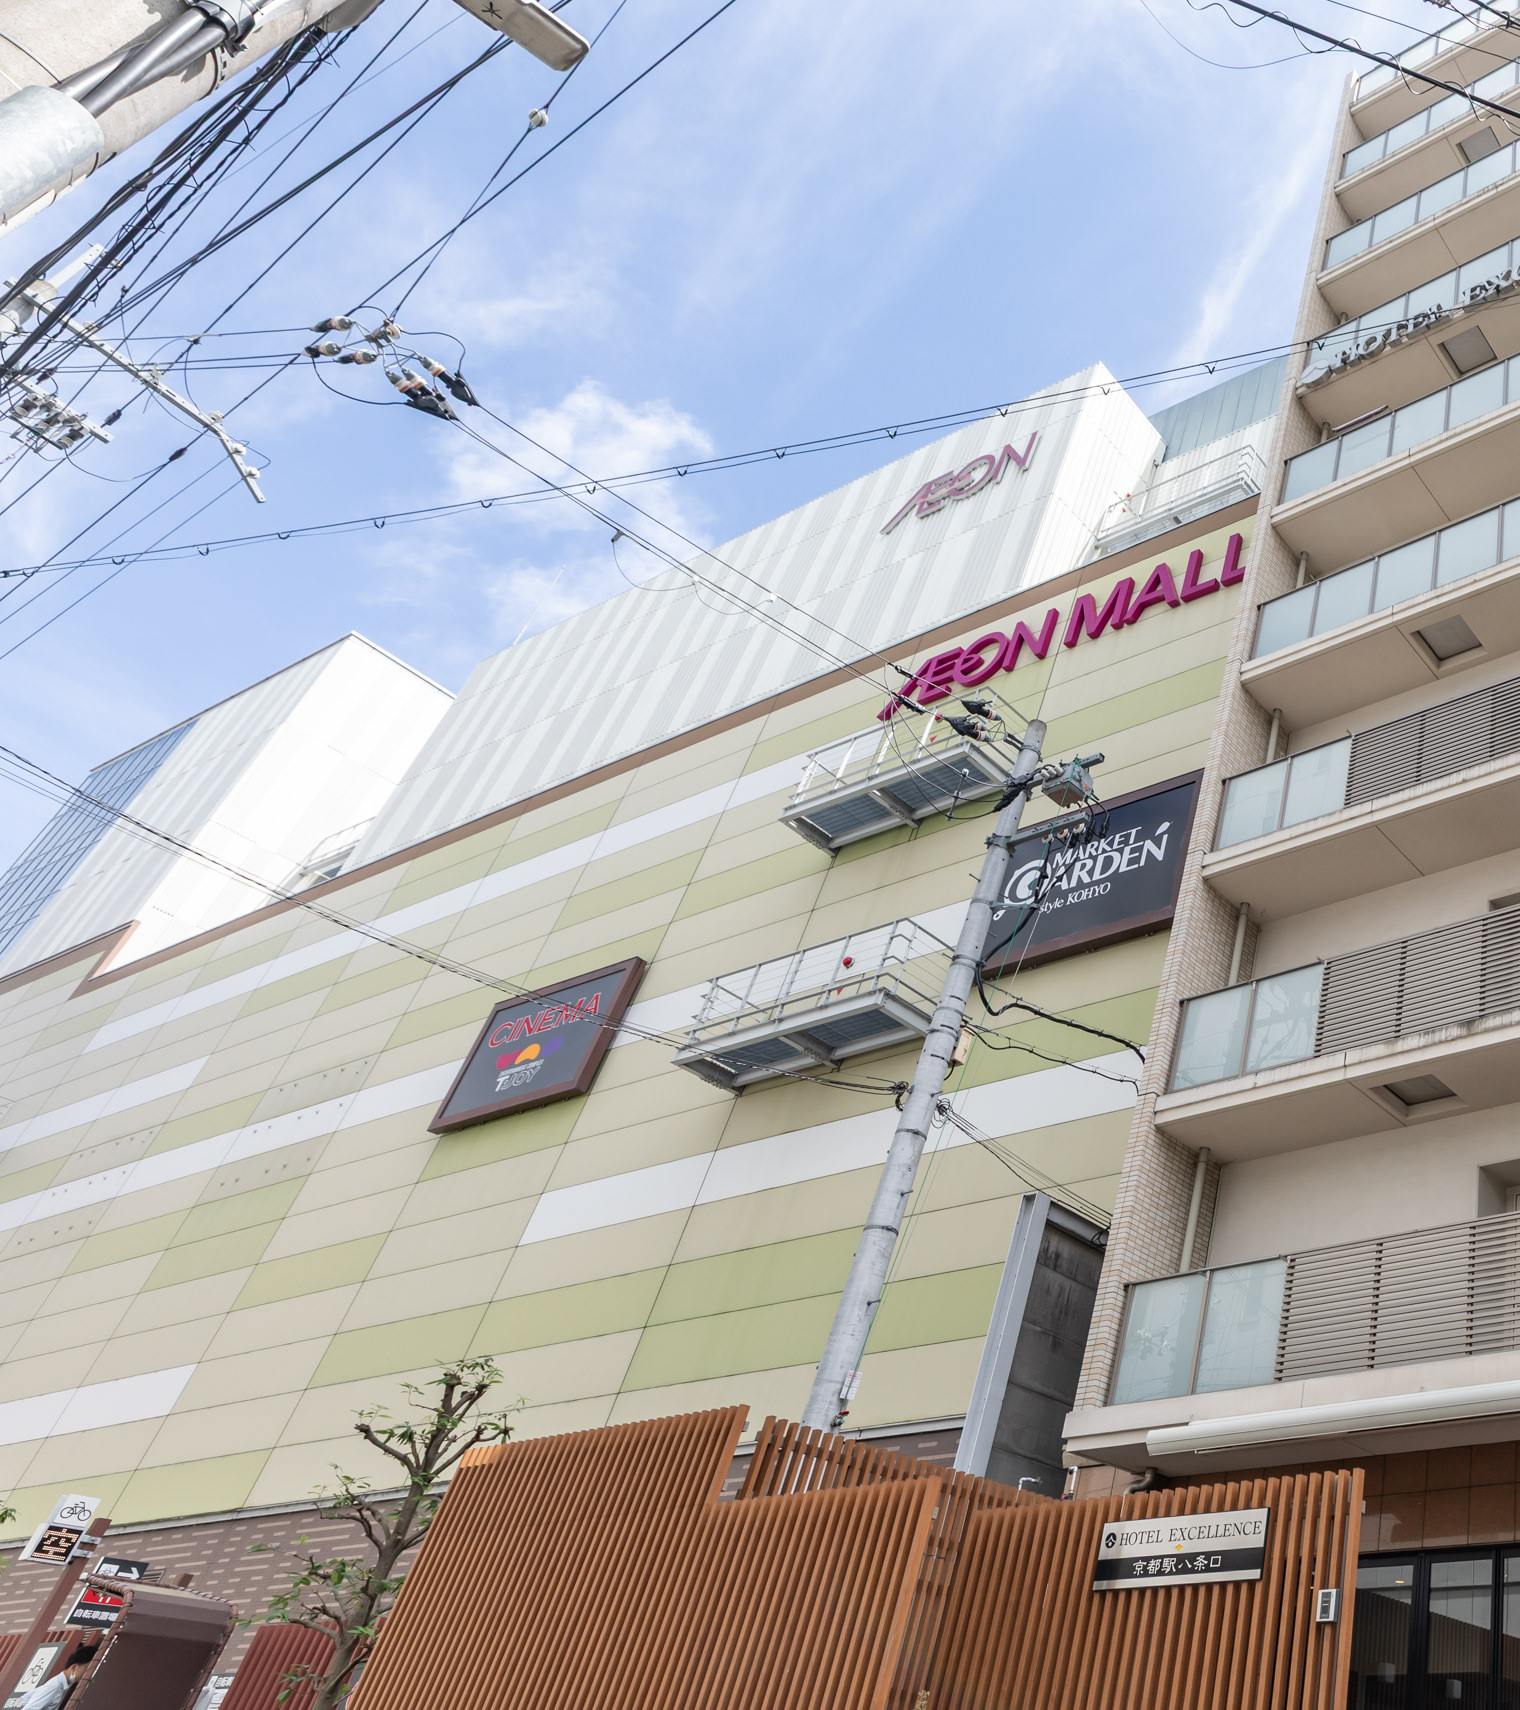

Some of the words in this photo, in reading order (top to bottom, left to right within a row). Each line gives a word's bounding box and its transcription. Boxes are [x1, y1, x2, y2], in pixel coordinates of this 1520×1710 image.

[1331, 303, 1451, 374] HOTEL
[1063, 533, 1247, 649] MALL
[1053, 826, 1142, 868] MARKET
[993, 834, 1169, 921] GARDEN
[1039, 897, 1065, 914] style
[1066, 882, 1111, 905] KOHYO
[488, 992, 601, 1048] CINEMA
[32, 1528, 79, 1560] 空
[1119, 1530, 1163, 1547] HOTEL
[1168, 1521, 1263, 1542] EXCELLENCE
[1132, 1555, 1222, 1576] 京都駅八条口
